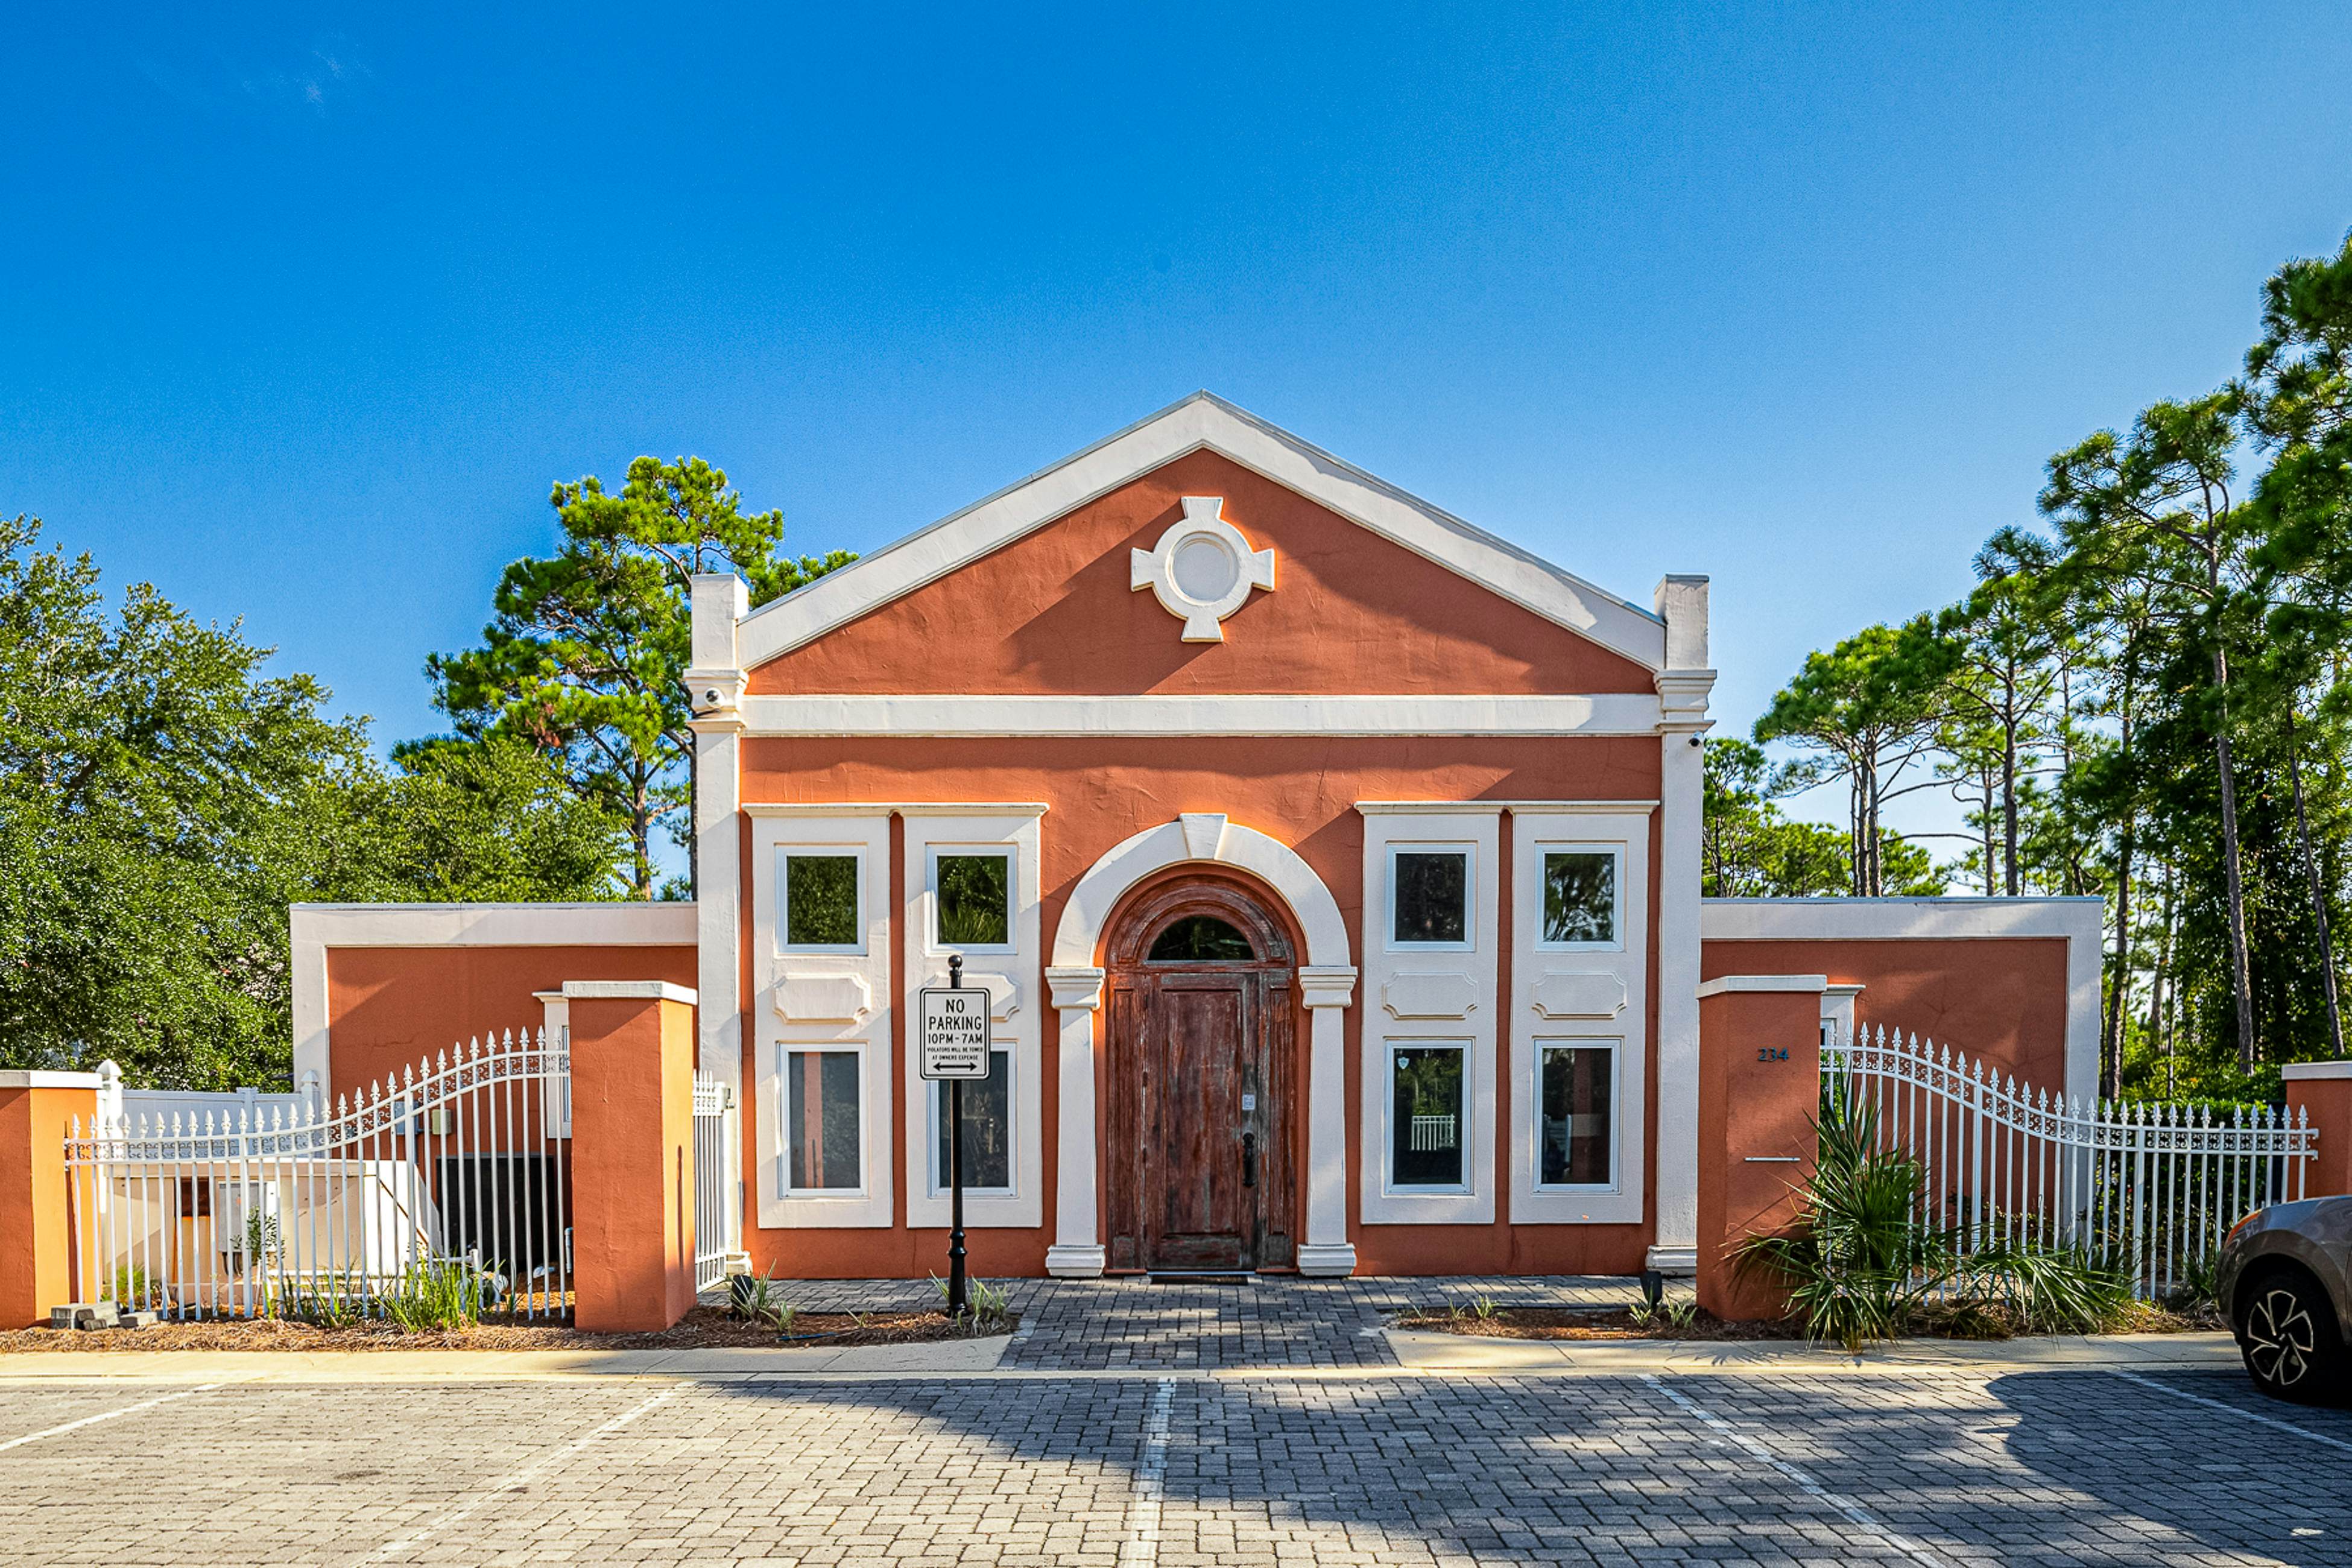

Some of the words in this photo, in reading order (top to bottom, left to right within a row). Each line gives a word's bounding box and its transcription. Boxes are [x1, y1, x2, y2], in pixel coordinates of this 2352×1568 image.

[946, 999, 965, 1013] NO
[929, 1016, 982, 1030] PARKING
[1757, 1047, 1789, 1062] 234
